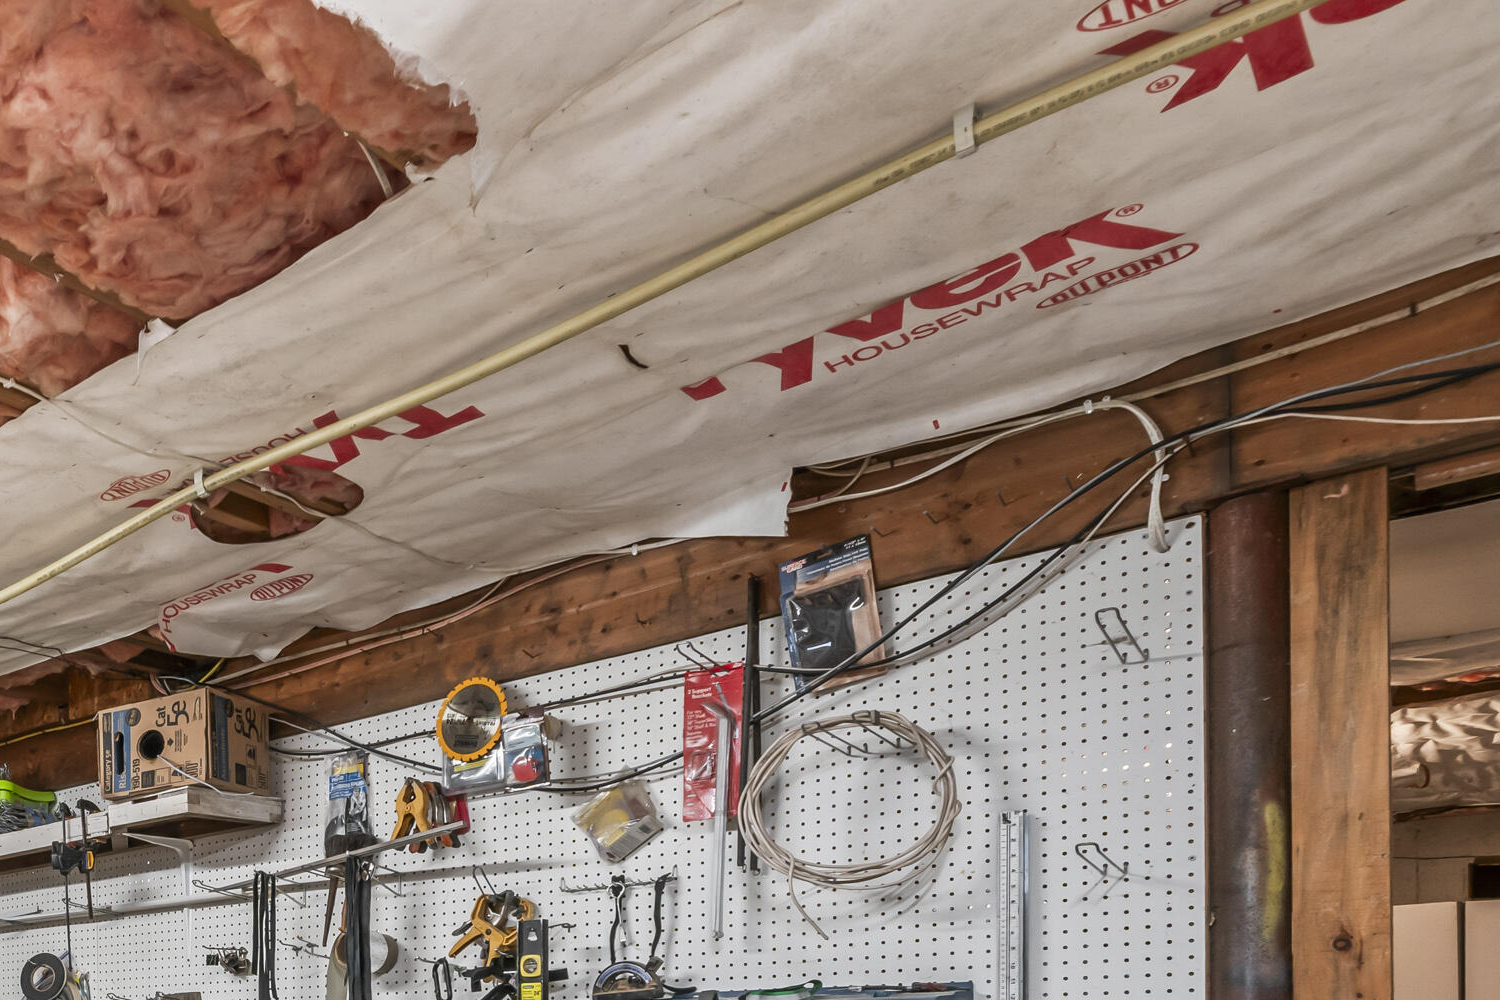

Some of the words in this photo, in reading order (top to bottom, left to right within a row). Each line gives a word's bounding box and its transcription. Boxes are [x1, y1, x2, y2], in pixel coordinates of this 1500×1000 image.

[823, 256, 1096, 373] HOUSEWRAP
[155, 706, 166, 727] Cat
[167, 700, 189, 727] 5e
[234, 708, 243, 734] Cat
[243, 708, 259, 740] 5e
